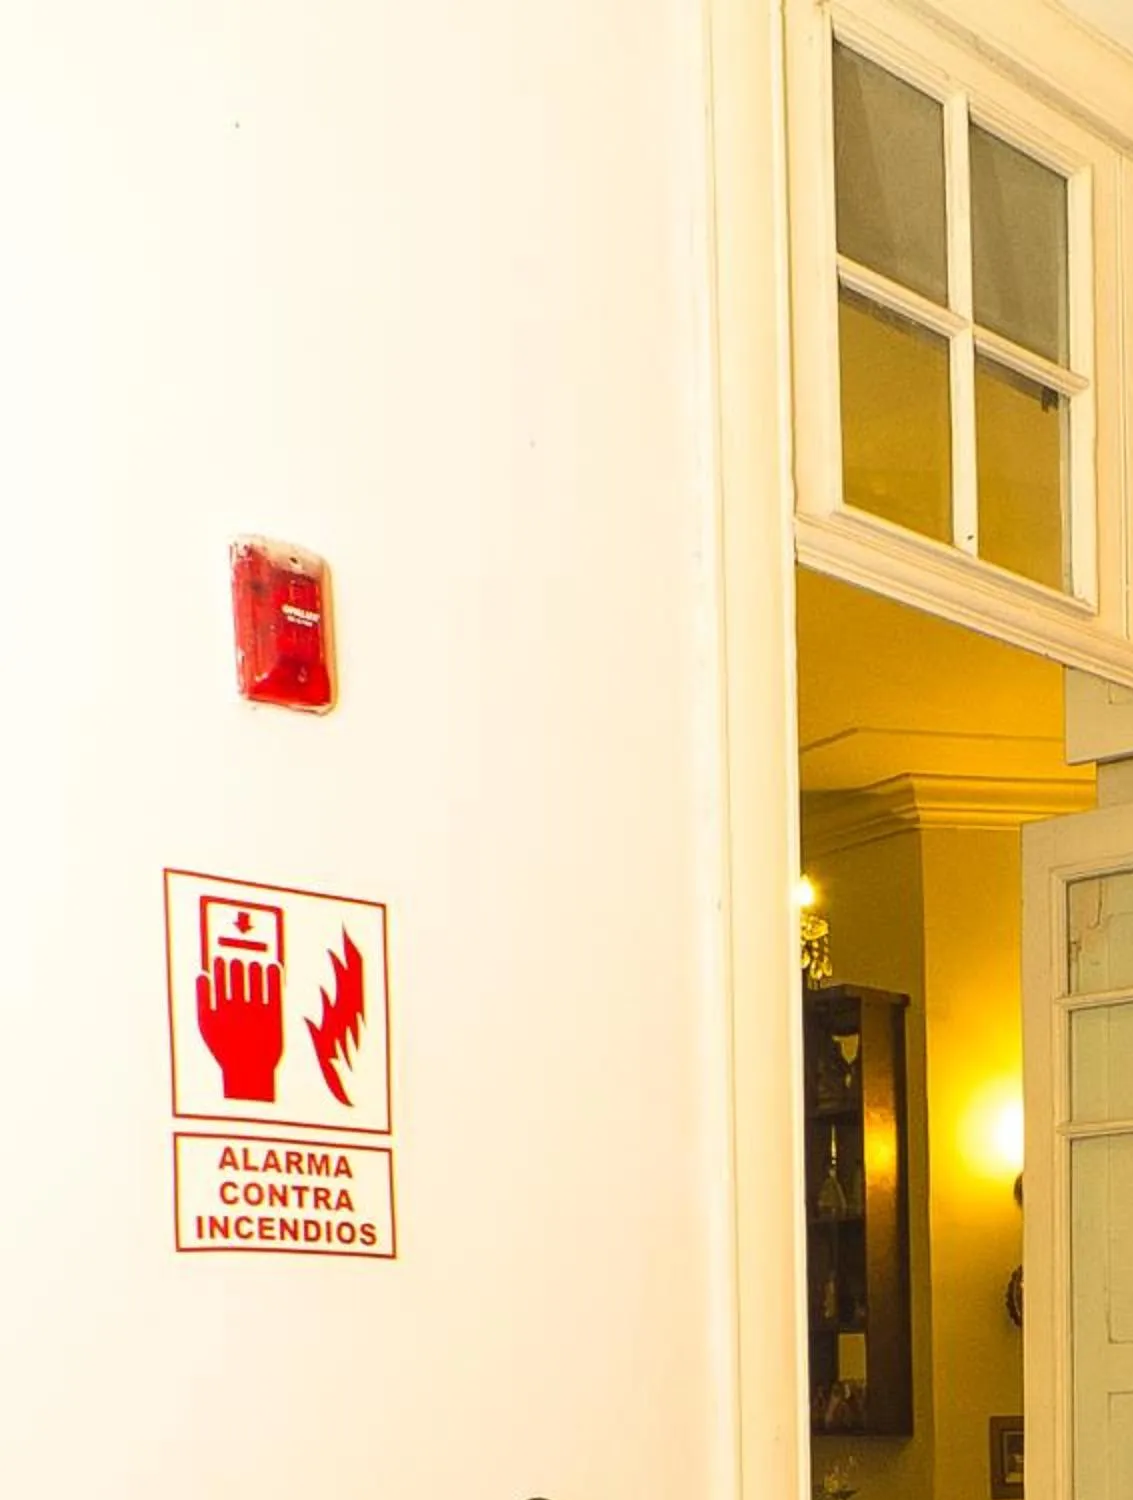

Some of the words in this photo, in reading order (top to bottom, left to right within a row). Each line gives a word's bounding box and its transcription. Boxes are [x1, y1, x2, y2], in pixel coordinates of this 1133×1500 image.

[218, 1146, 353, 1179] ALARMA
[219, 1181, 354, 1213] CONTRA
[196, 1214, 377, 1247] INCENDIOS
